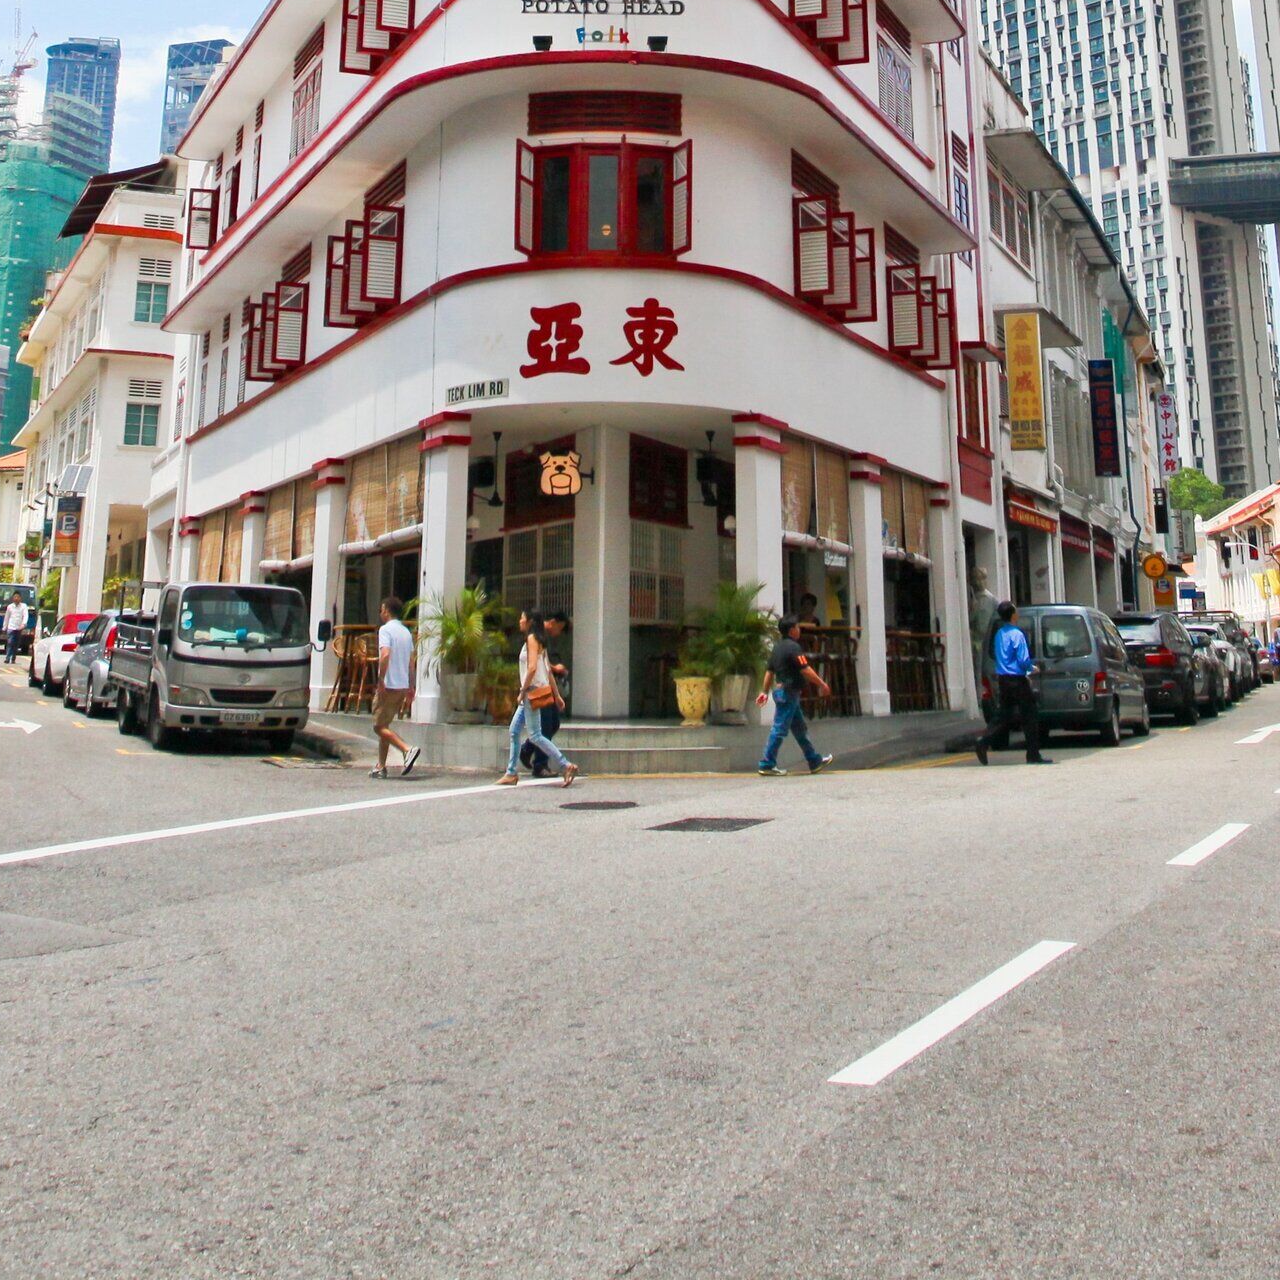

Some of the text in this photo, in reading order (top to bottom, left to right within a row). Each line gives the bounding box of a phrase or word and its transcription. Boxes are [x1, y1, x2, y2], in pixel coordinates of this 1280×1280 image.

[447, 379, 503, 403] TECK LIM RD
